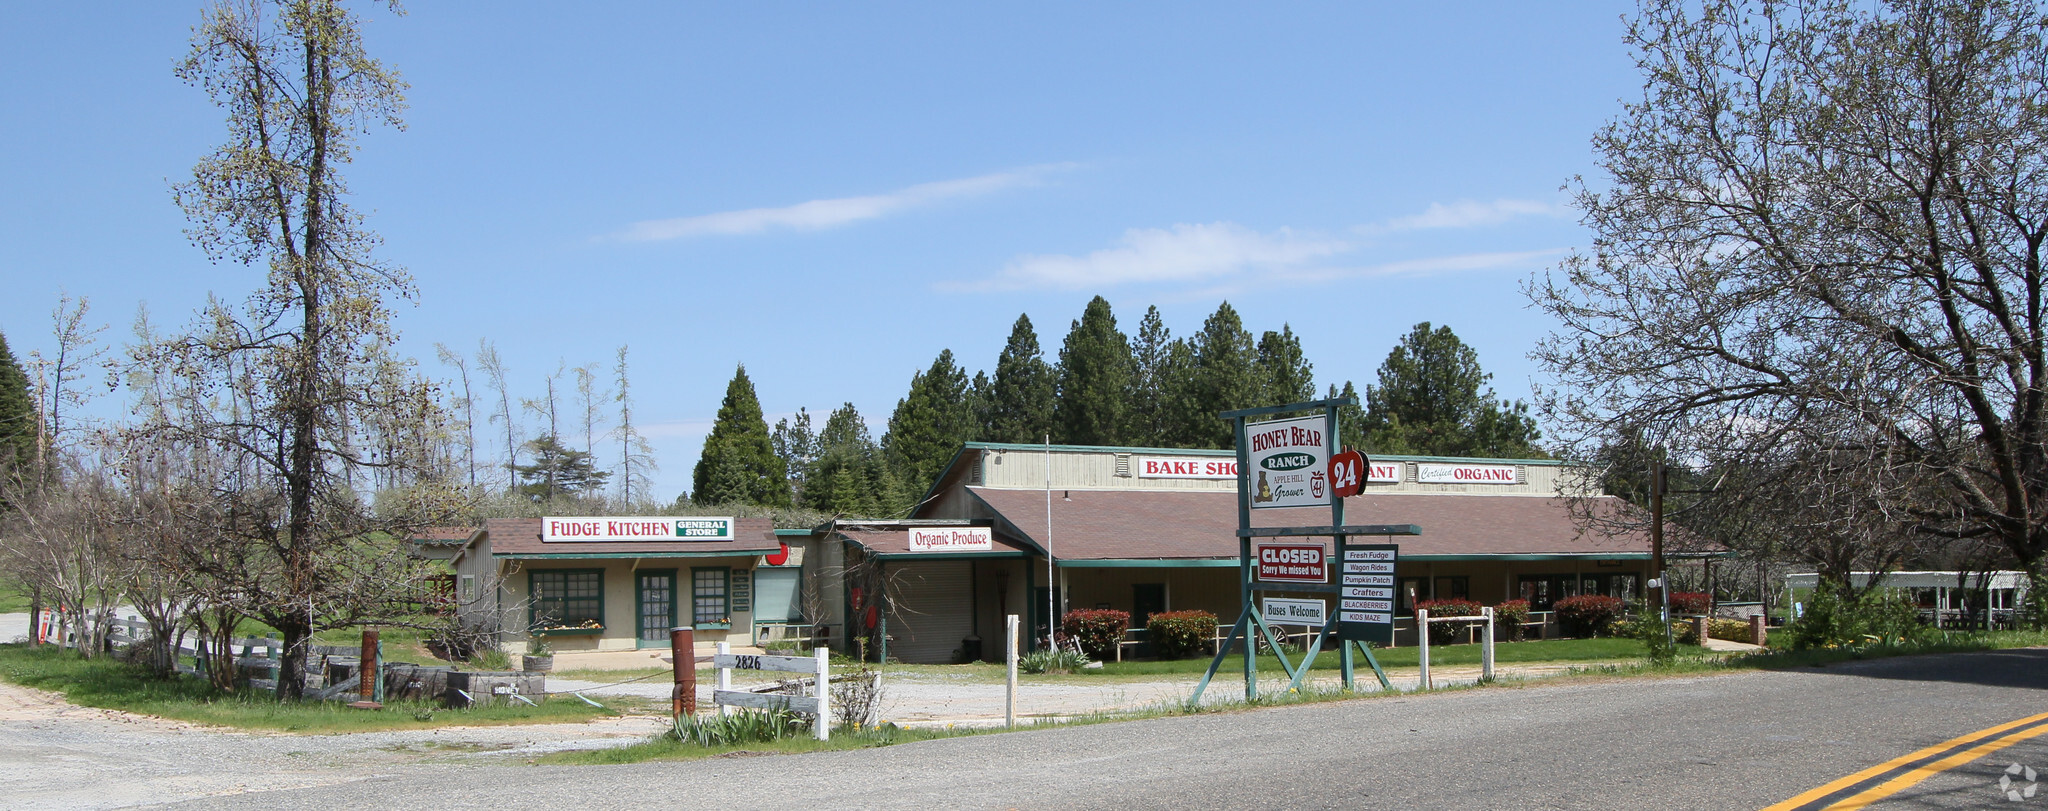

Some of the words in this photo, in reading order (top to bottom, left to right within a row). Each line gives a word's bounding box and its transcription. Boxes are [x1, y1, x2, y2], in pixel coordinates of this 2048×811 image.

[1252, 429, 1288, 452] HONEY
[1291, 426, 1322, 447] BEAR
[1146, 461, 1199, 475] BAKE
[1268, 455, 1309, 469] RANCH
[1274, 475, 1291, 484] APPLE
[1291, 474, 1304, 483] HILL
[1334, 459, 1357, 489] 24
[1421, 467, 1453, 480] Certified
[1454, 468, 1513, 481] ORGANIC
[1275, 485, 1304, 502] Grower
[551, 521, 600, 536] FUDGE
[608, 521, 669, 536] KITCHEN
[677, 521, 725, 529] GENERAL
[685, 528, 718, 536] STORE
[915, 531, 948, 549] Organic
[952, 531, 987, 545] Produce
[1262, 549, 1320, 564] CLOSED
[1369, 552, 1388, 560] Fudge
[1262, 565, 1278, 575] Sorry
[1279, 565, 1287, 574] We
[1288, 566, 1309, 575] missed
[1310, 566, 1321, 576] You
[1350, 564, 1369, 572] Wagon
[1352, 588, 1384, 597] Crafters
[1268, 605, 1286, 616] Buses
[1289, 605, 1320, 618] Welcome
[1344, 601, 1388, 609] BLACKBERRIES
[735, 655, 761, 670] 2826
